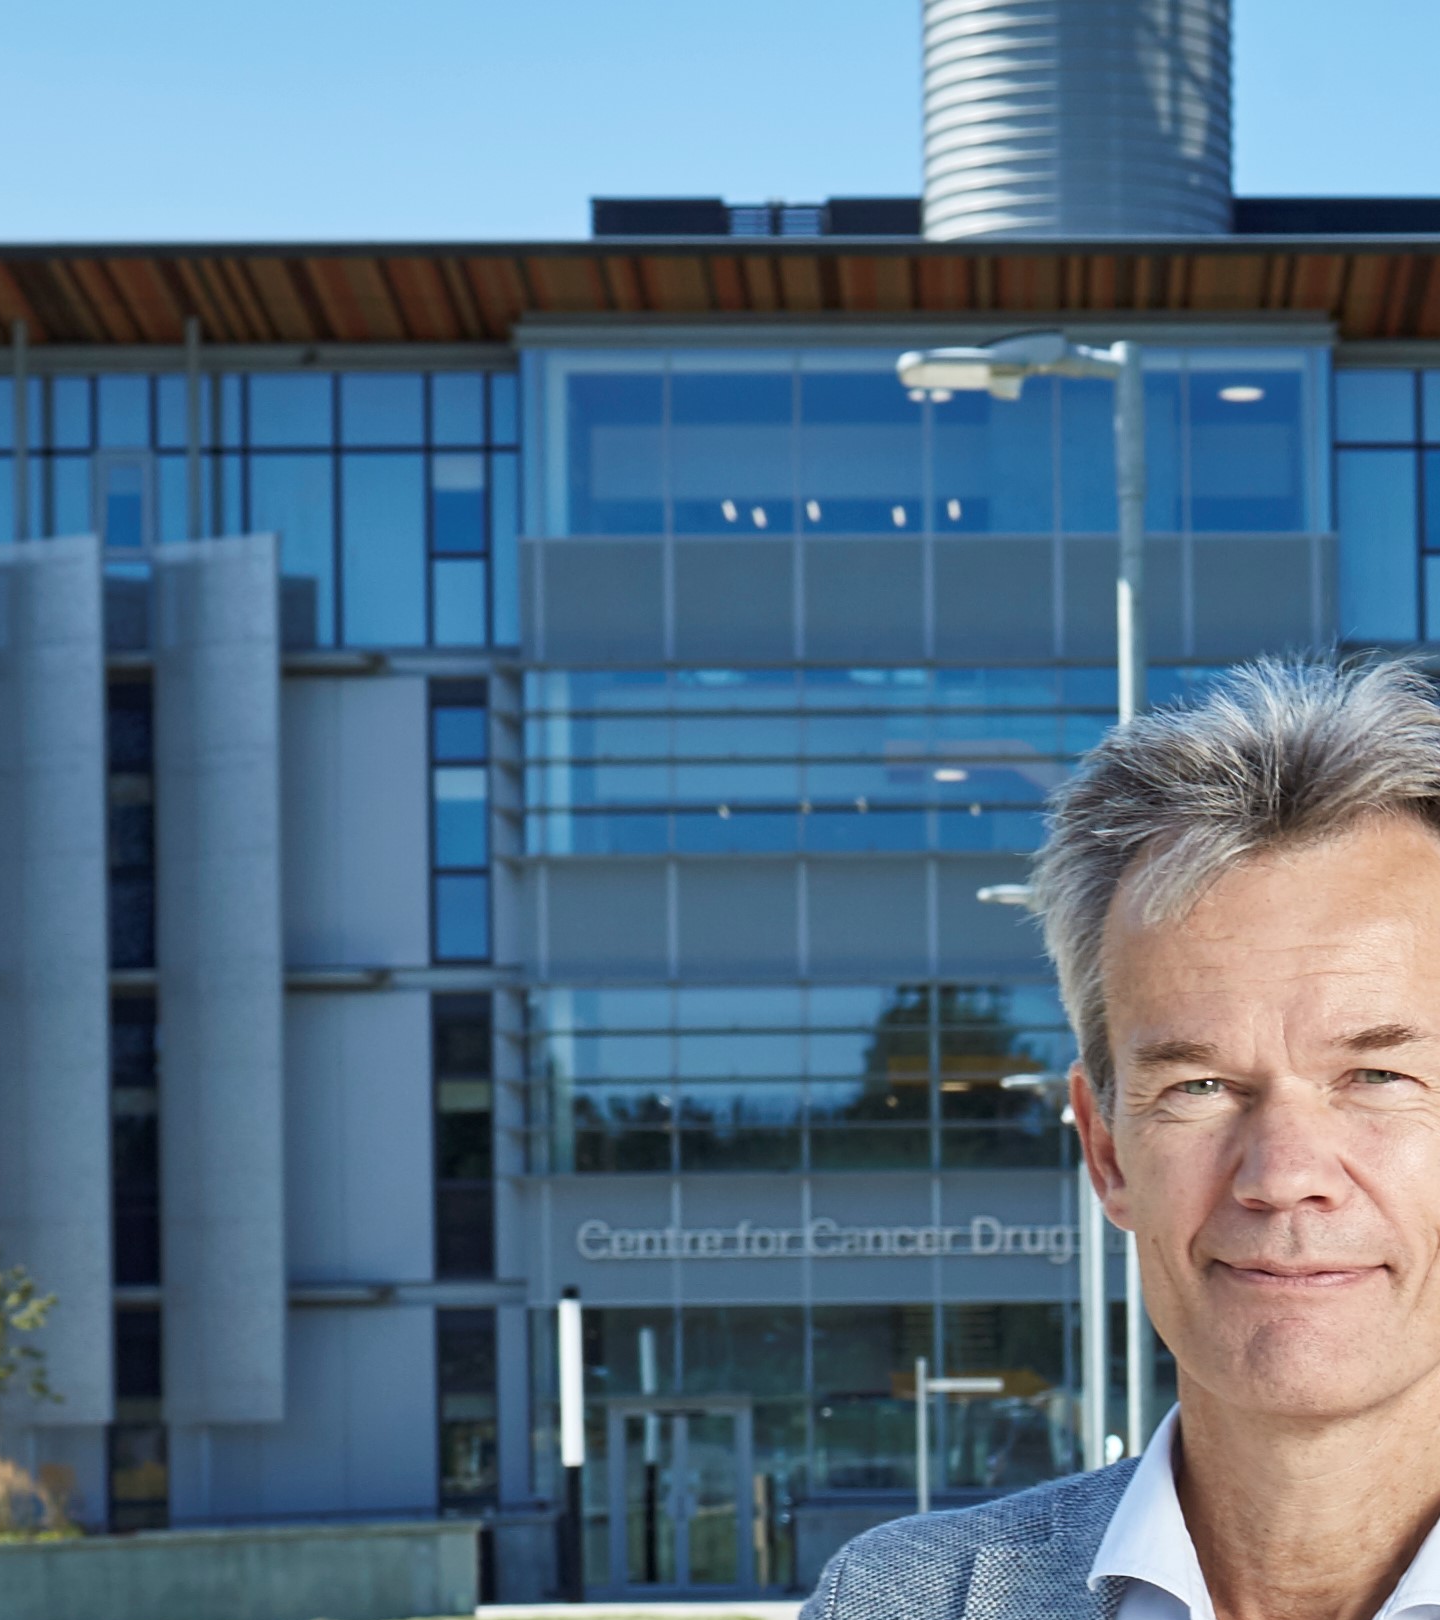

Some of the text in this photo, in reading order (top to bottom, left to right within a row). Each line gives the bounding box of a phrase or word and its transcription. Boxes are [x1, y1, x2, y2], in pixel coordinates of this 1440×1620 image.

[577, 1219, 723, 1260] Centre
[735, 1219, 796, 1257] for
[807, 1217, 960, 1256] Cancer
[971, 1215, 1072, 1264] Drug
